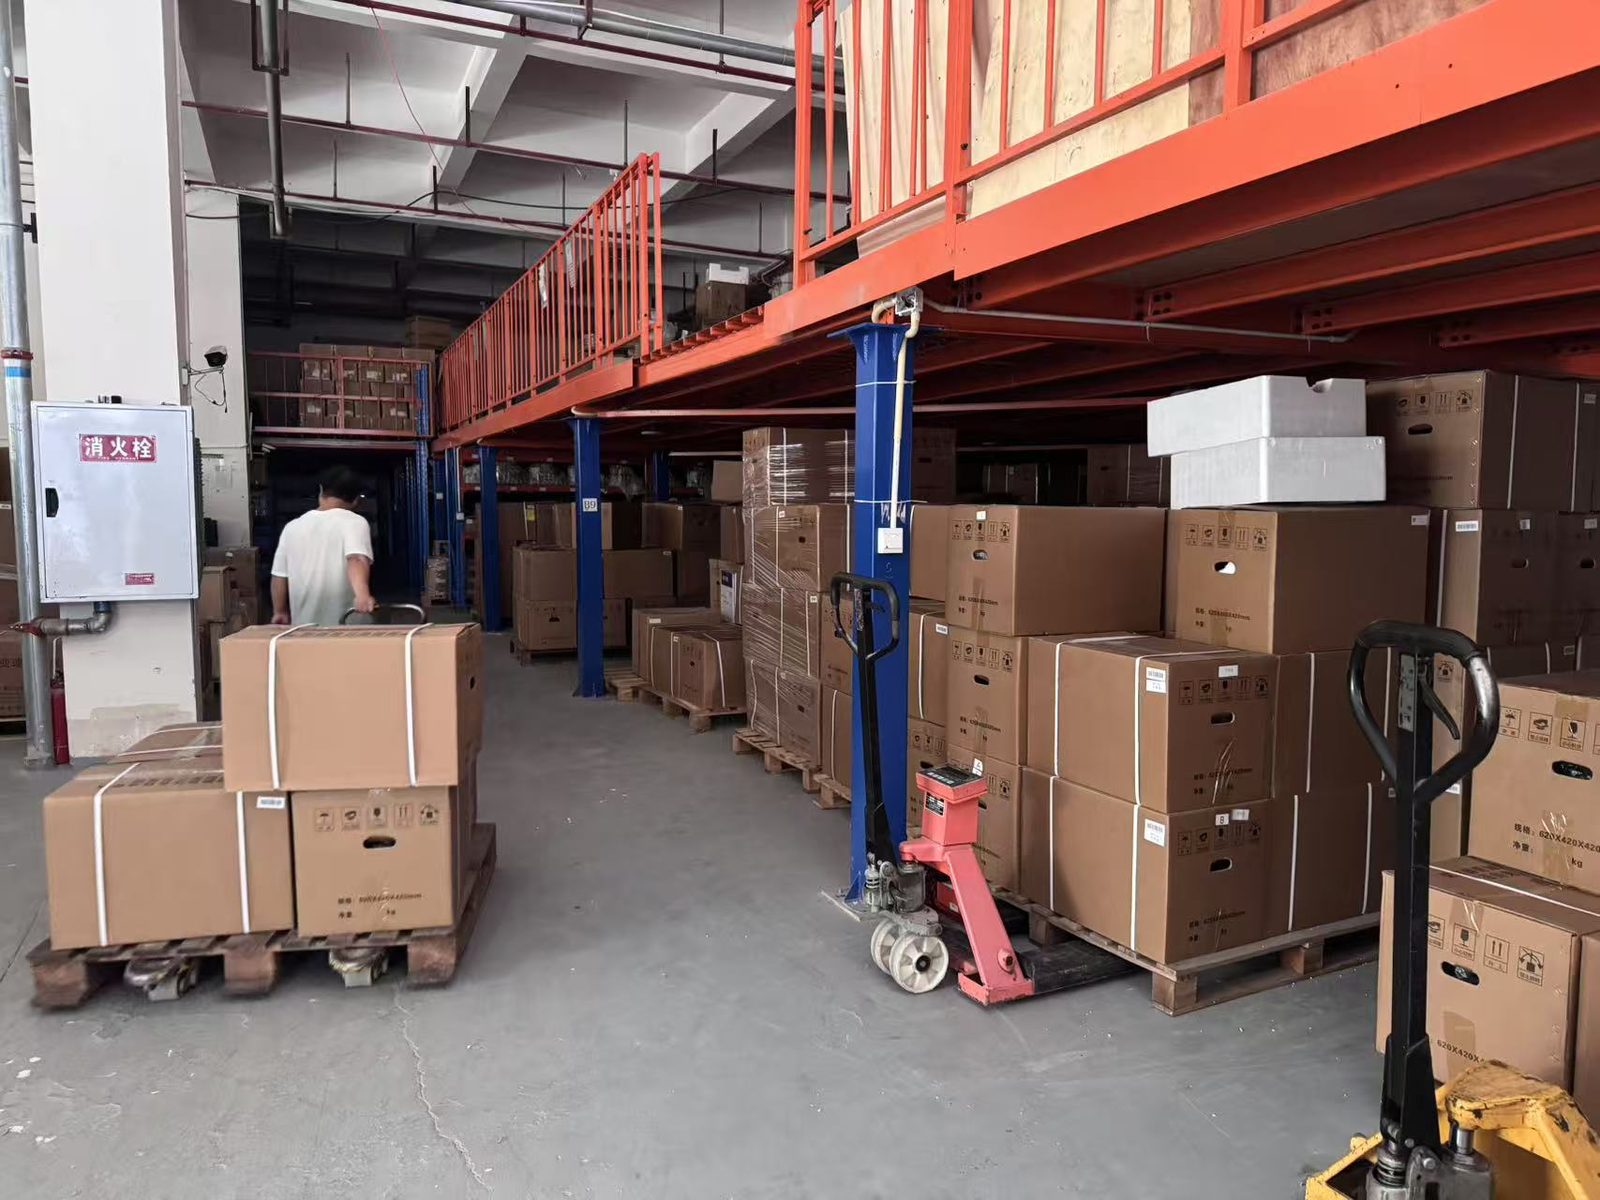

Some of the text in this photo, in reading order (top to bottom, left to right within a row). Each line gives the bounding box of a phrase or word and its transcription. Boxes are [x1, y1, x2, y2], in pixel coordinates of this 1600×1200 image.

[84, 436, 152, 458] 消火栓
[1571, 857, 1583, 868] kg
